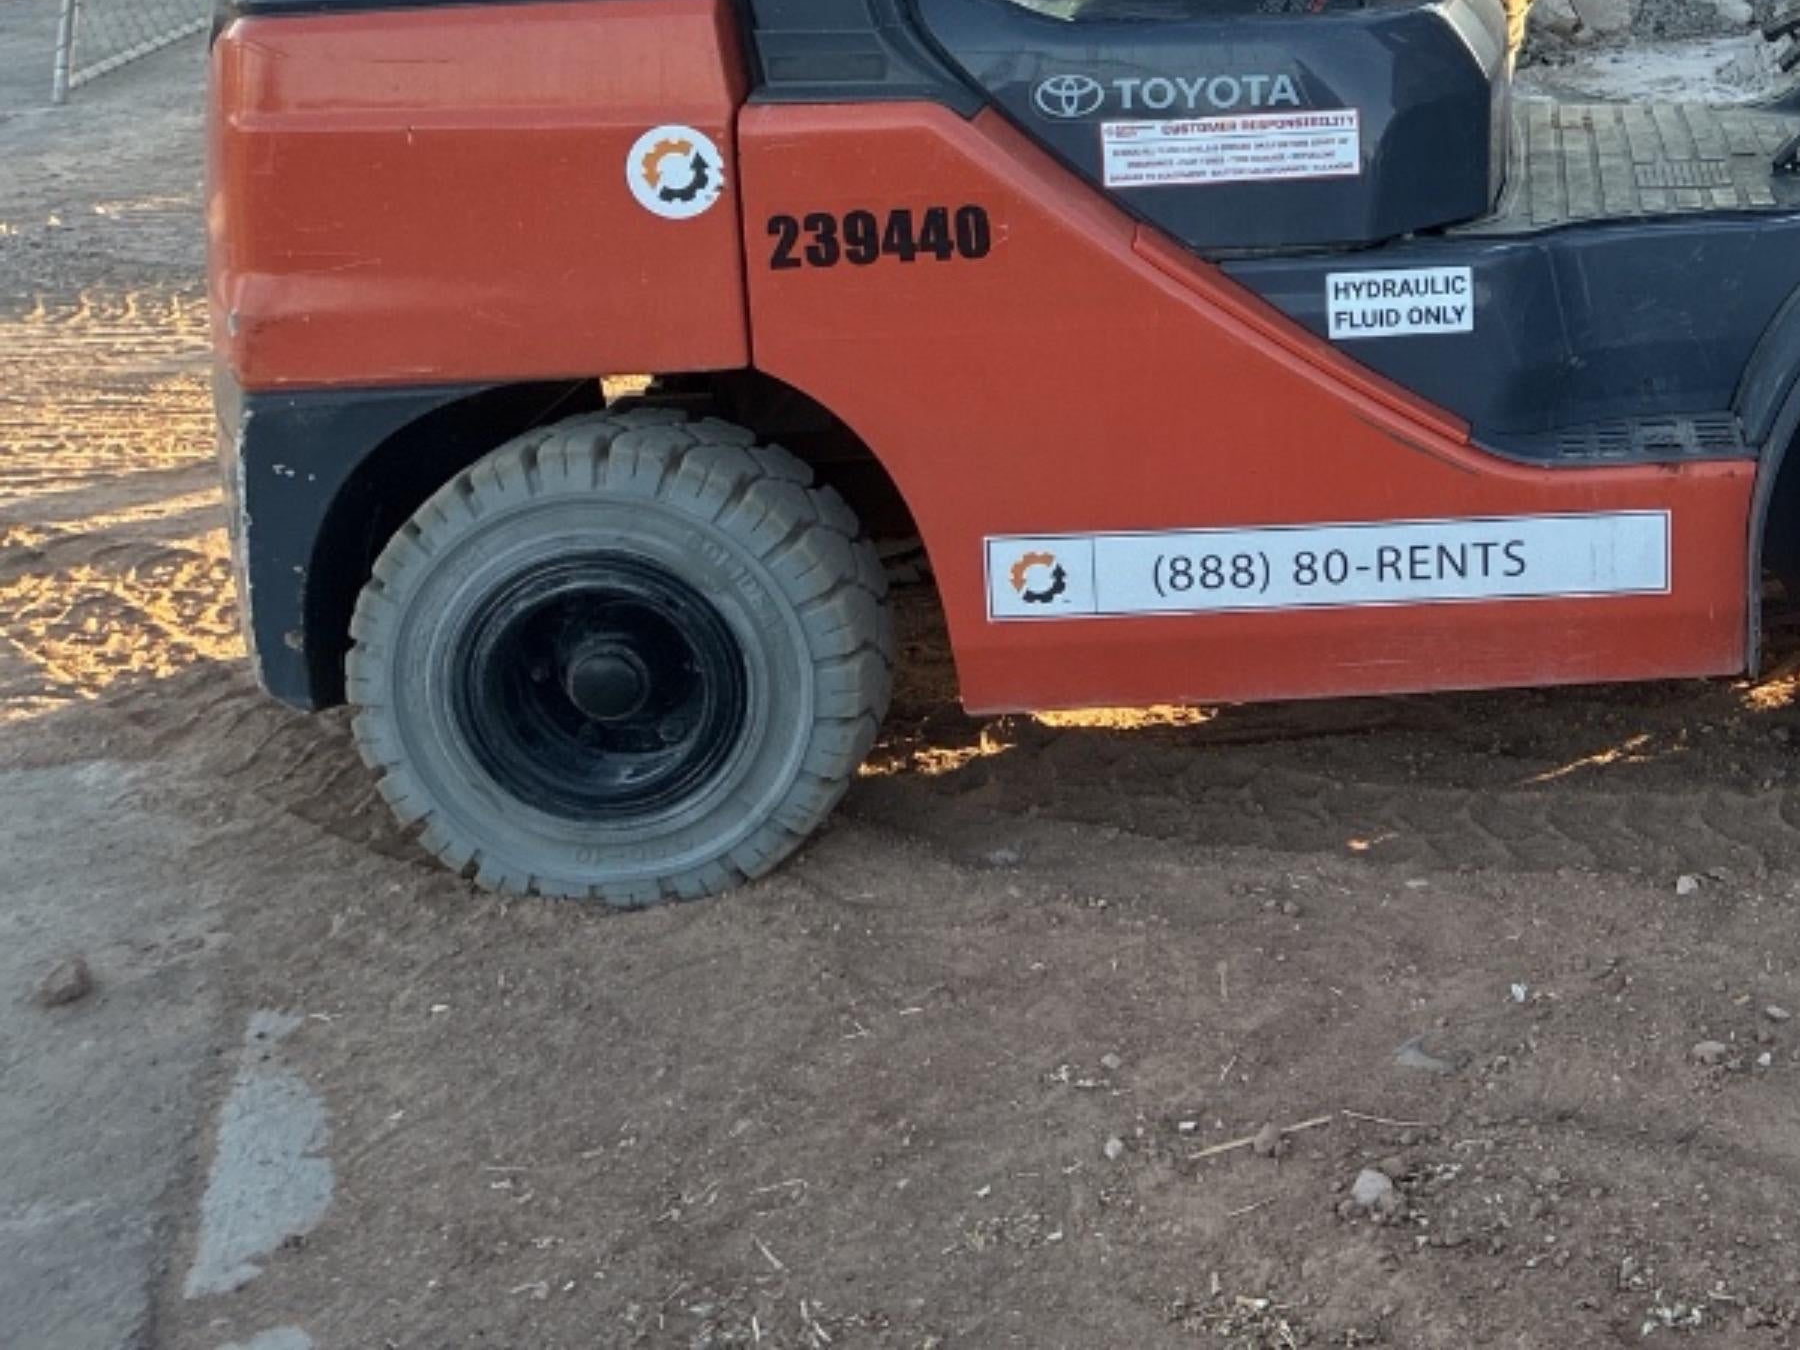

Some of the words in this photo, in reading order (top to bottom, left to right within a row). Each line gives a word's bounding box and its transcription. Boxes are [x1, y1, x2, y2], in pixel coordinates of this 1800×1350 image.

[1113, 74, 1299, 109] TOYOTA
[1160, 120, 1237, 136] CUSTOMER
[1240, 115, 1355, 132] RESPONSIBILITY
[766, 204, 992, 270] 239440
[1333, 275, 1467, 301] HYDRAULIC
[1334, 308, 1401, 331] FLUID
[1407, 305, 1467, 326] ONLY
[1152, 553, 1271, 596] (888)
[1292, 539, 1528, 586] 80-RENTS
